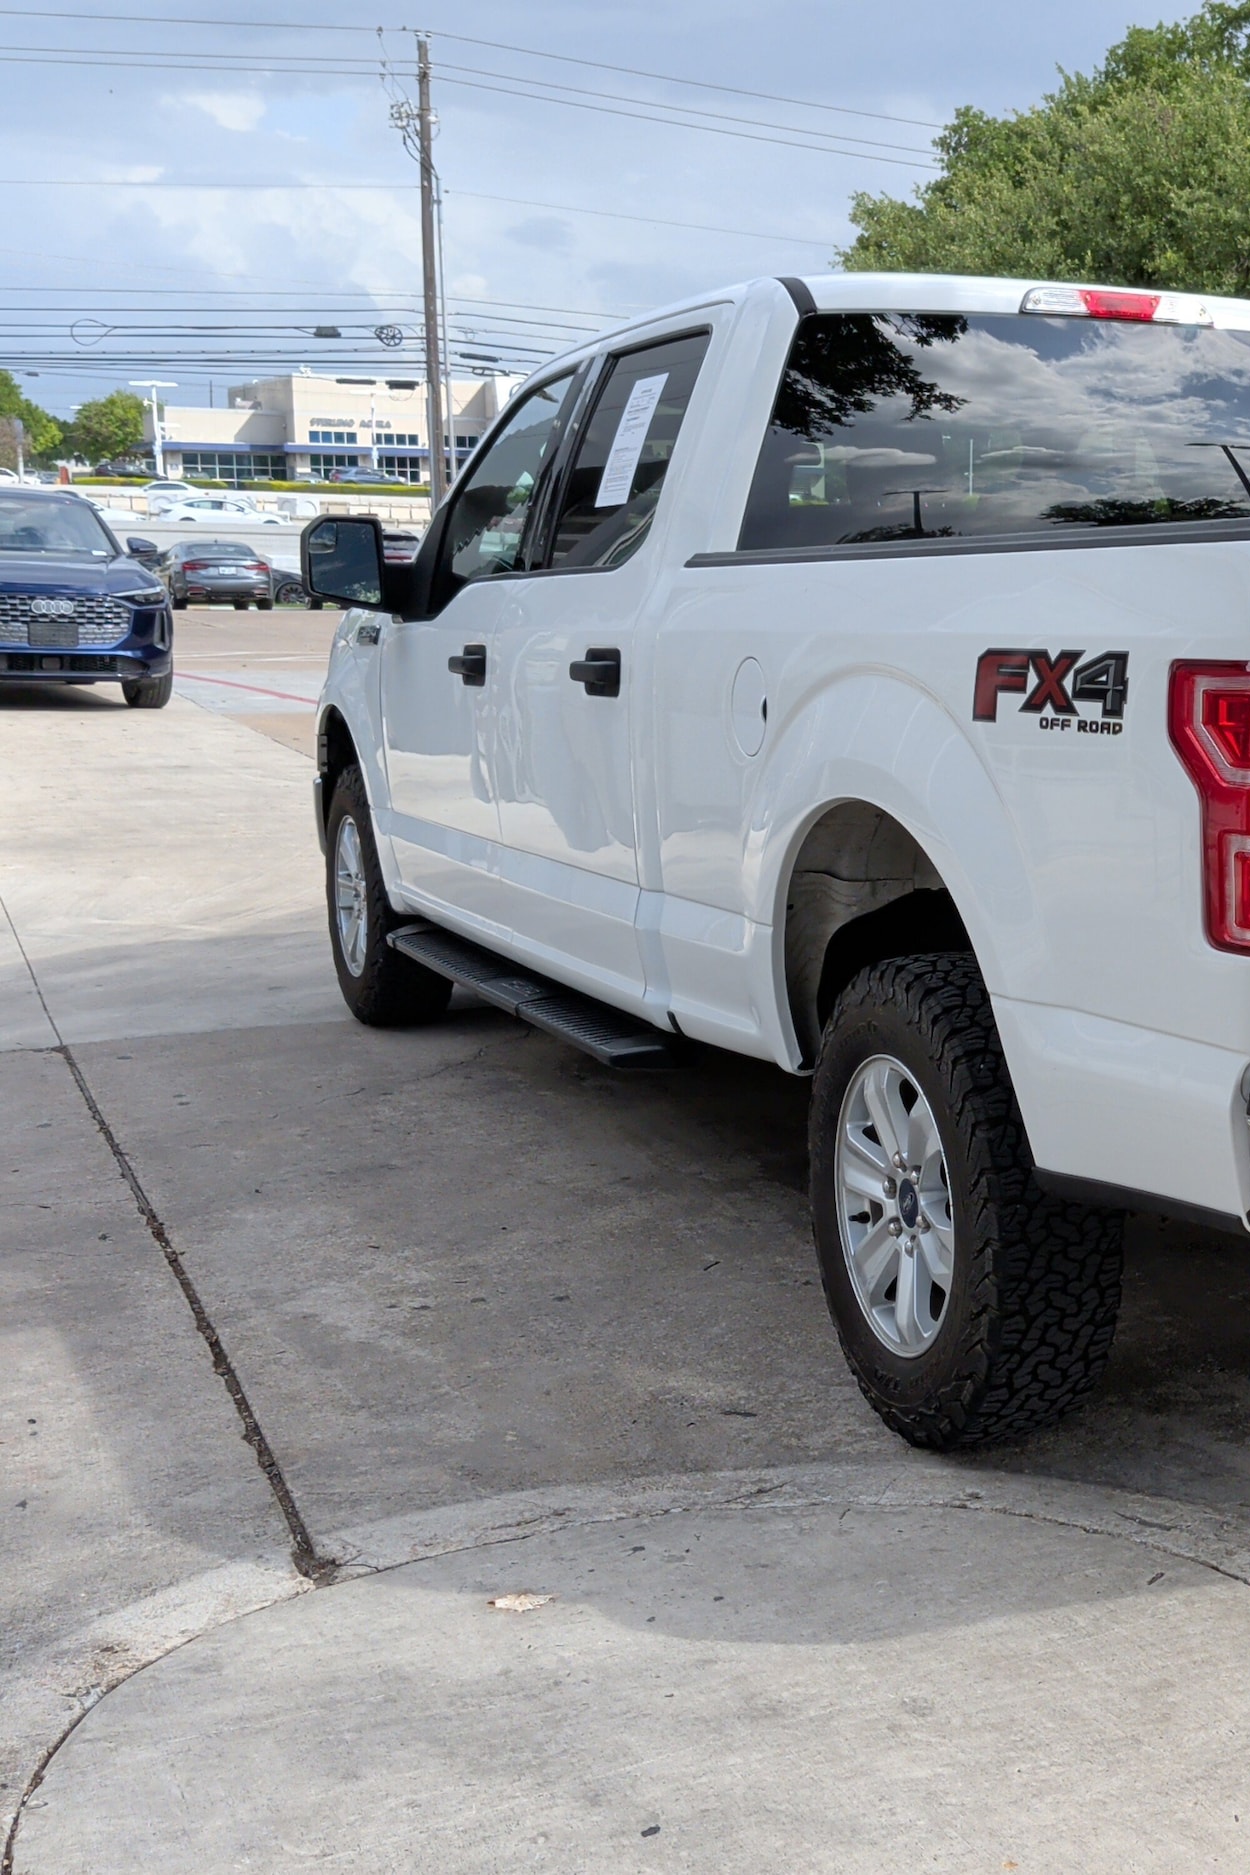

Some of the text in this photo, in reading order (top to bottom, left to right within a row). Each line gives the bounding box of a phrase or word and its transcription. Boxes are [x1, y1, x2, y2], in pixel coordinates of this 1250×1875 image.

[972, 647, 1129, 723] FX4
[1039, 717, 1123, 735] OFF ROAD
